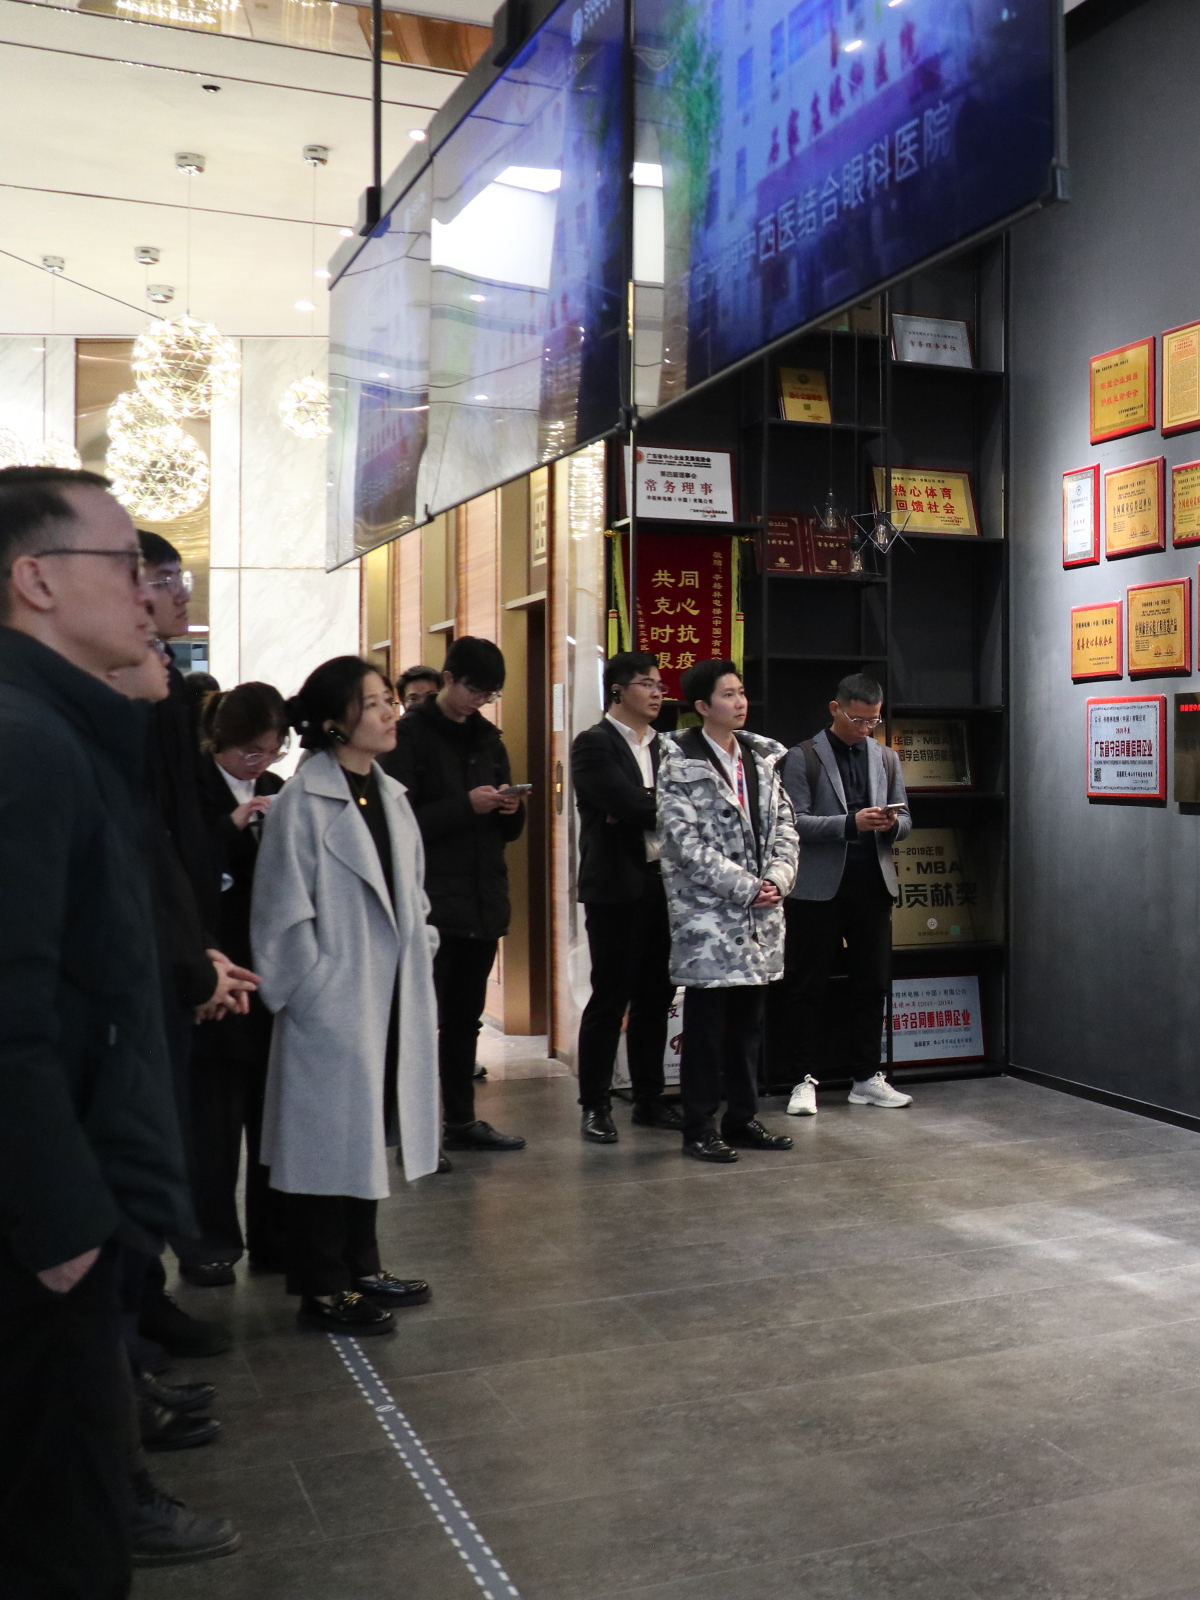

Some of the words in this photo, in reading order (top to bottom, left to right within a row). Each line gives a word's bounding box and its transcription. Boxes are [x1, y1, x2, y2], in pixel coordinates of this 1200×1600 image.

[644, 479, 714, 496] 常务理事
[893, 483, 953, 500] 热心体育
[895, 499, 956, 516] 回馈社会
[675, 570, 700, 670] 同心抗疫
[1094, 739, 1153, 758] 广东省守合同重信用企业
[884, 1008, 971, 1031] 省守合同重信用企业
